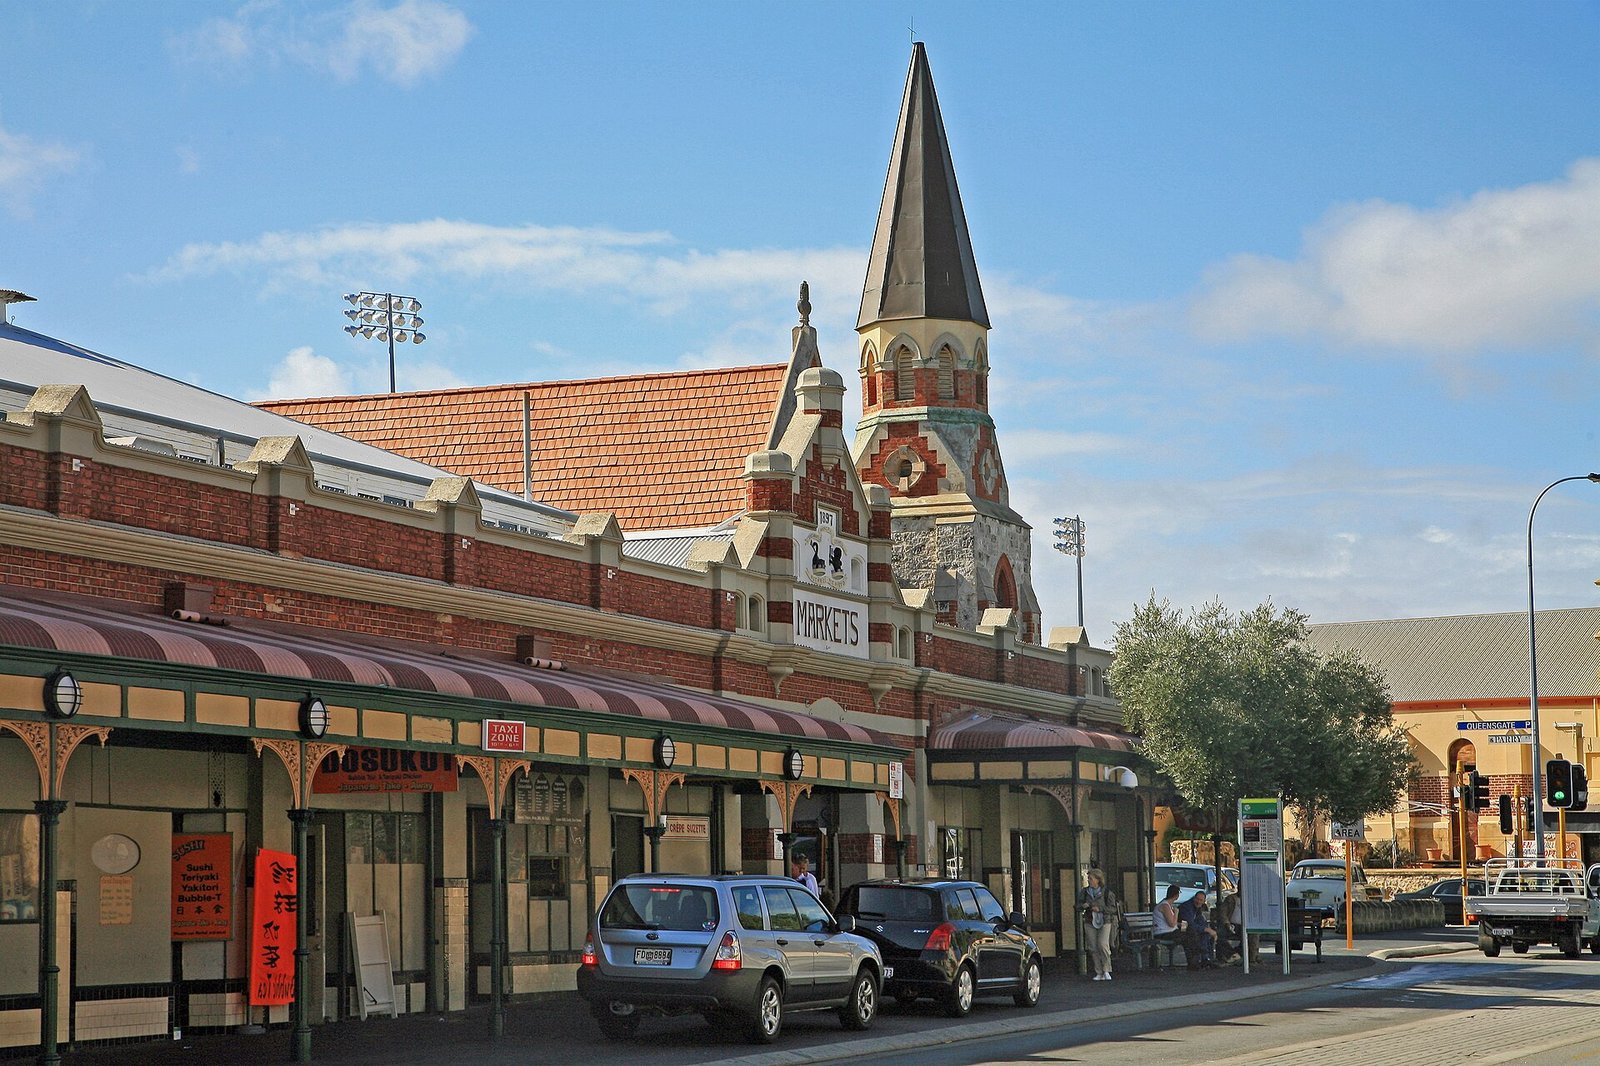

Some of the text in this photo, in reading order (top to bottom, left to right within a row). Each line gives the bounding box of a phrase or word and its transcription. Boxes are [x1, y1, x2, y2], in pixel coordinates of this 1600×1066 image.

[819, 511, 834, 526] 1897
[796, 600, 859, 646] MARKETS
[492, 724, 518, 734] TAXI
[1466, 721, 1516, 730] QUEENSGATE
[491, 733, 519, 743] ZONE
[1496, 735, 1522, 743] PARRY
[687, 823, 706, 834] SUZETTE
[1334, 829, 1360, 837] AREA
[172, 840, 205, 862] SUSHI
[186, 864, 213, 872] Sushi
[181, 873, 219, 882] Teriyaki
[181, 884, 219, 892] Yakitori
[178, 894, 222, 903] Bubble-T
